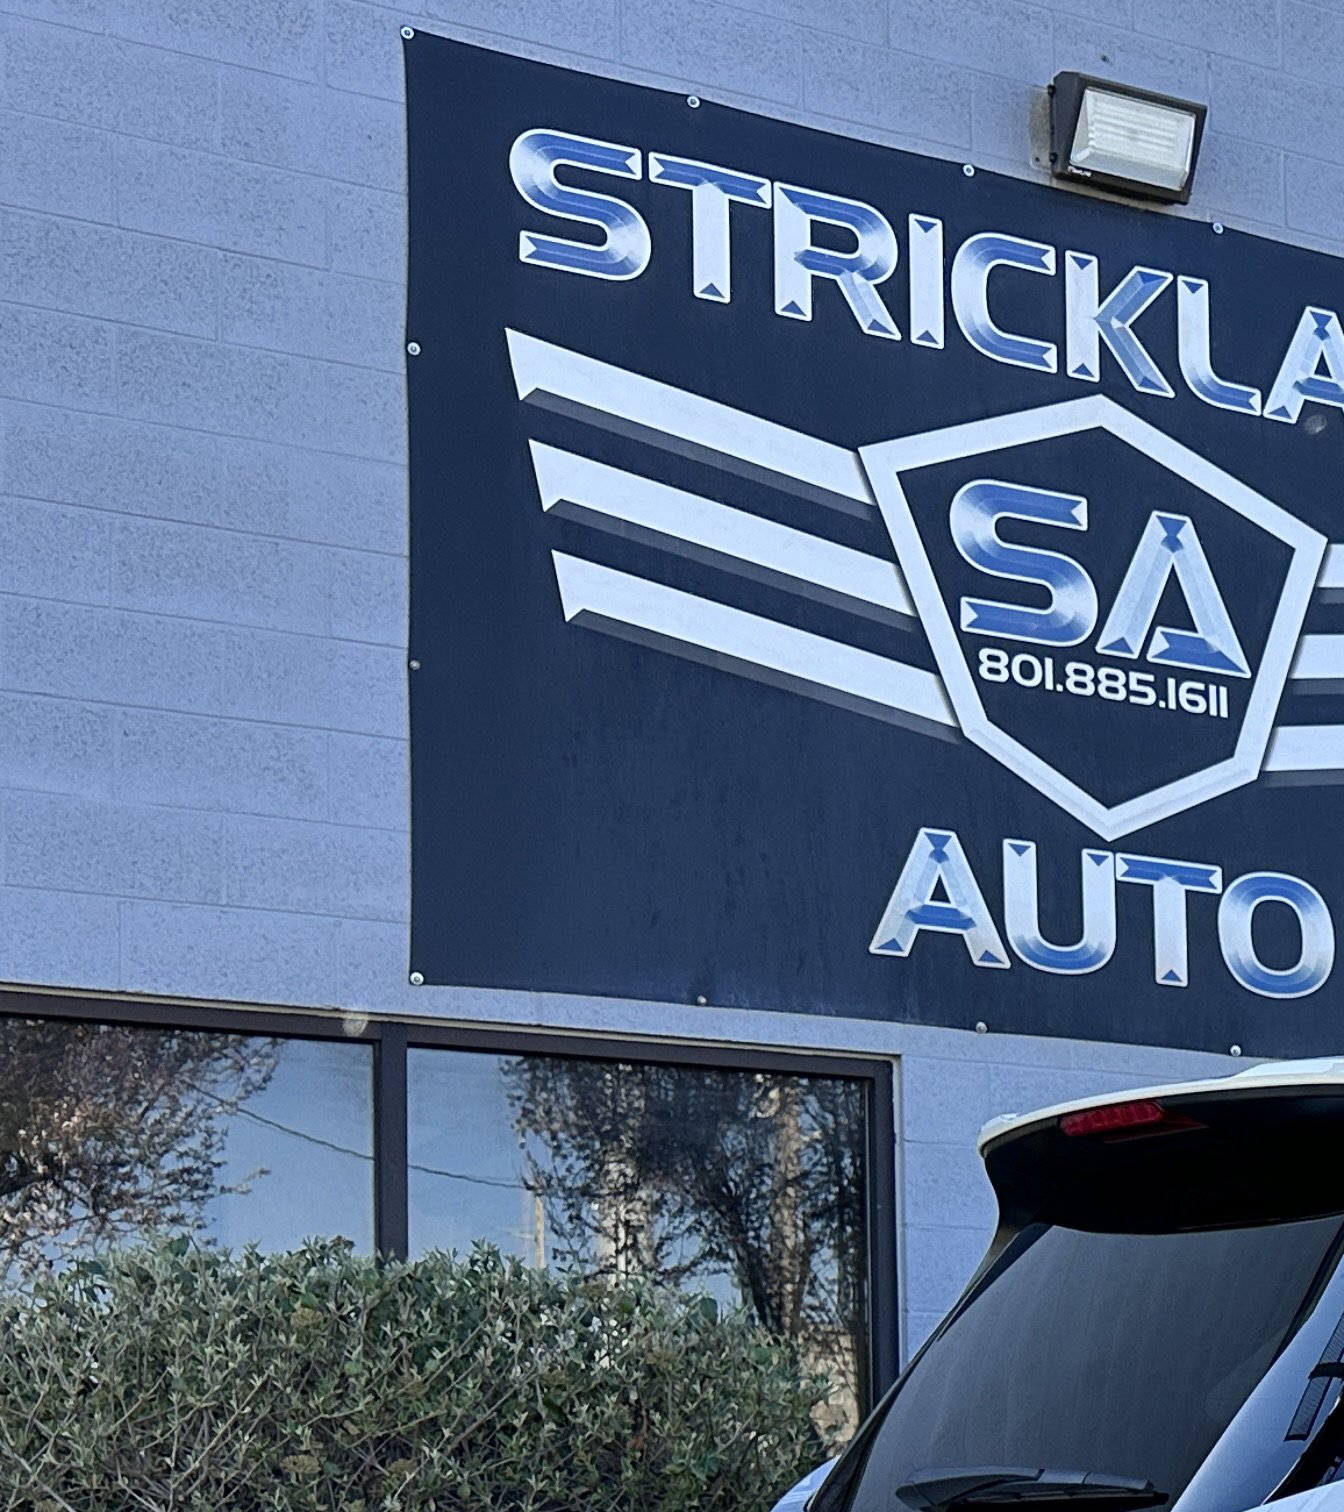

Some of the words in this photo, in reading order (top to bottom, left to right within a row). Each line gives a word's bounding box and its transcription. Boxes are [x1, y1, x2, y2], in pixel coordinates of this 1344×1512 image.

[949, 479, 1251, 678] SA
[977, 646, 1230, 720] 801.885.1611
[868, 827, 1335, 998] AUTO
